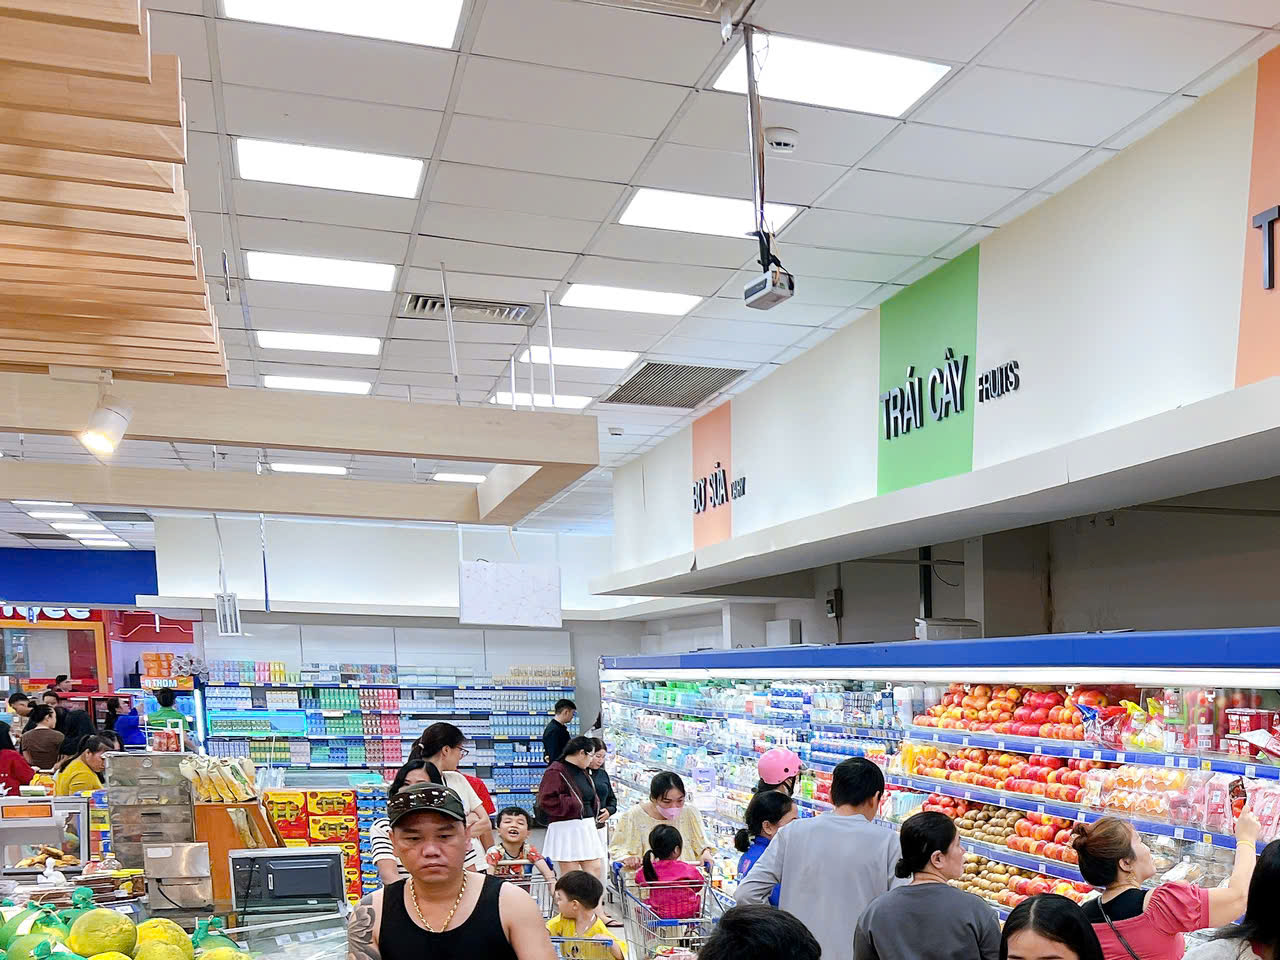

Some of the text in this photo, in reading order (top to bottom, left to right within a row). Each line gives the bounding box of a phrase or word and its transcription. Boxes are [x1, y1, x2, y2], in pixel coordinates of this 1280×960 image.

[879, 347, 969, 441] TRÁI CÂY
[977, 360, 1020, 403] FRUITS
